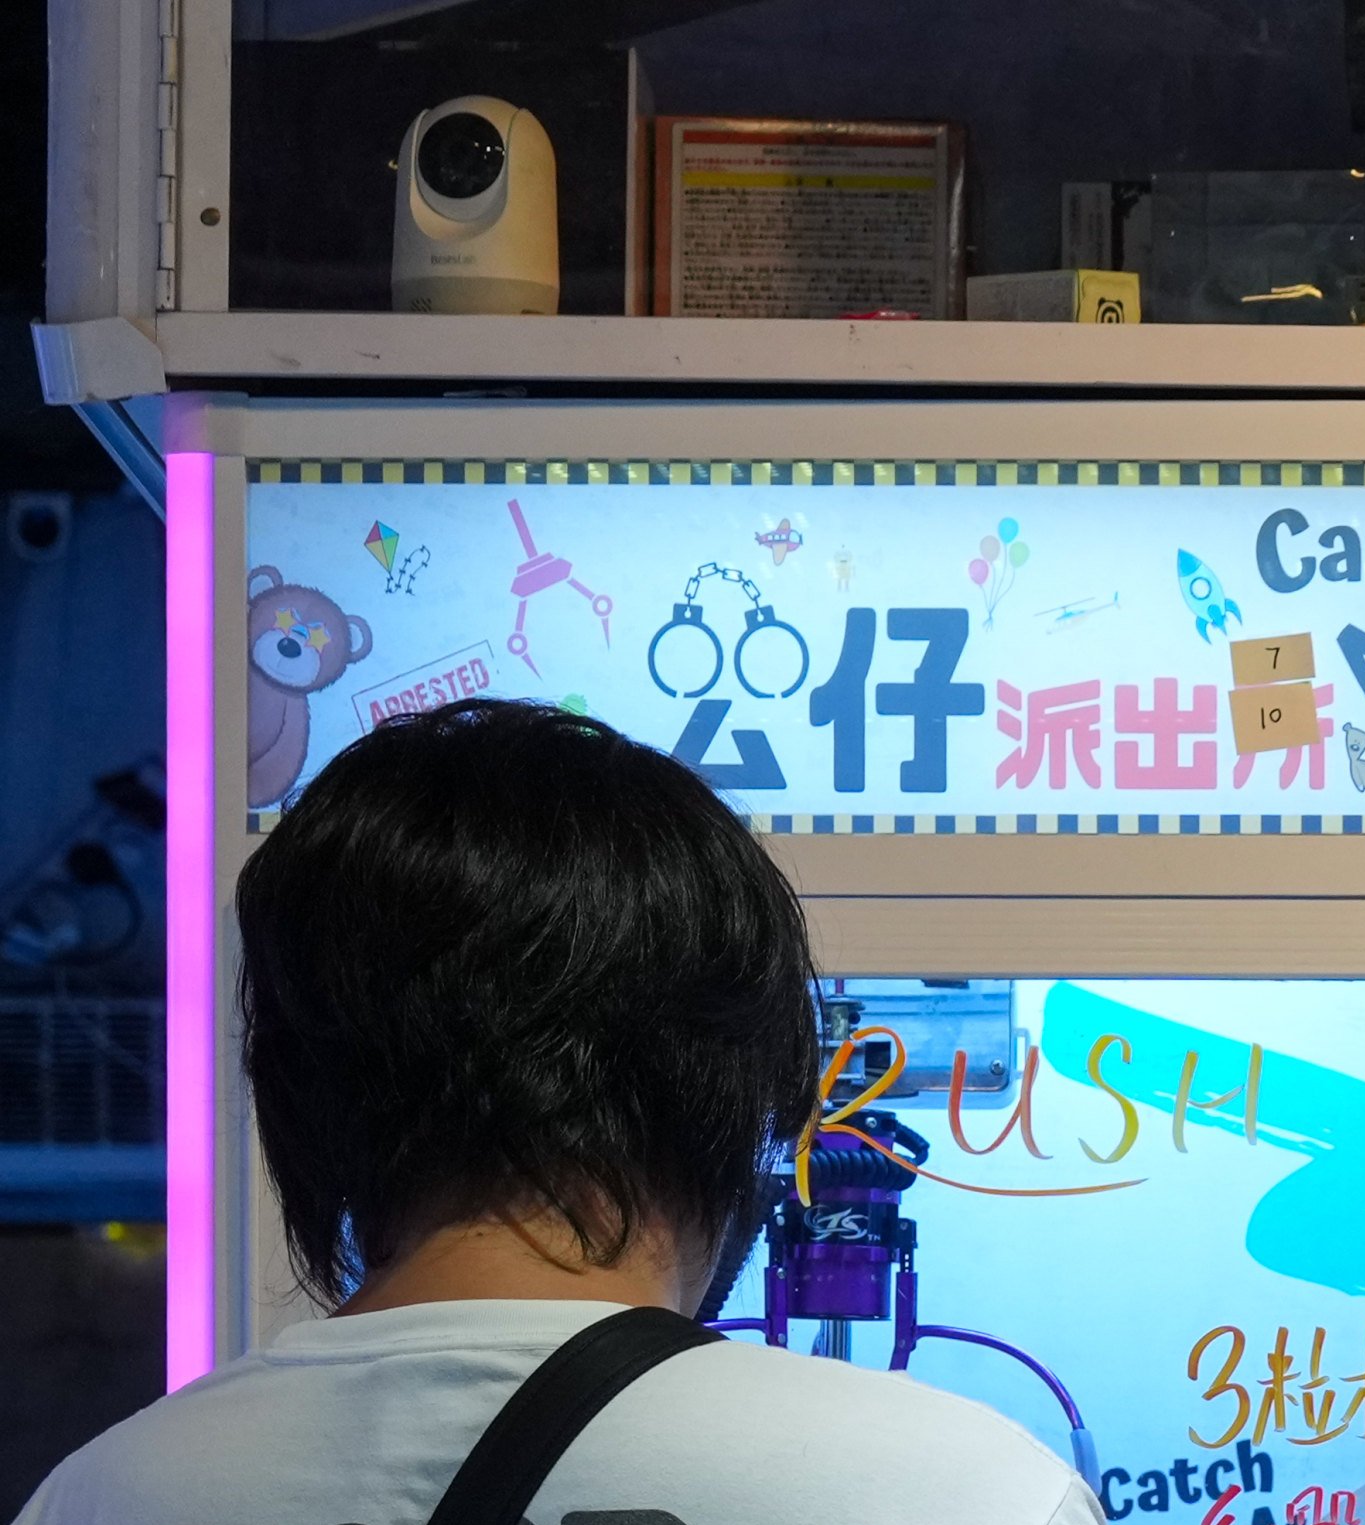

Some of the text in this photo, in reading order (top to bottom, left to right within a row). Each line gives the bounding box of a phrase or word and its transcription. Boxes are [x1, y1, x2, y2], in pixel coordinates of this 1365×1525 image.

[1264, 645, 1281, 671] 7
[1257, 704, 1283, 730] 10
[796, 1026, 1264, 1207] RUSH
[1100, 1440, 1274, 1521] Catch
